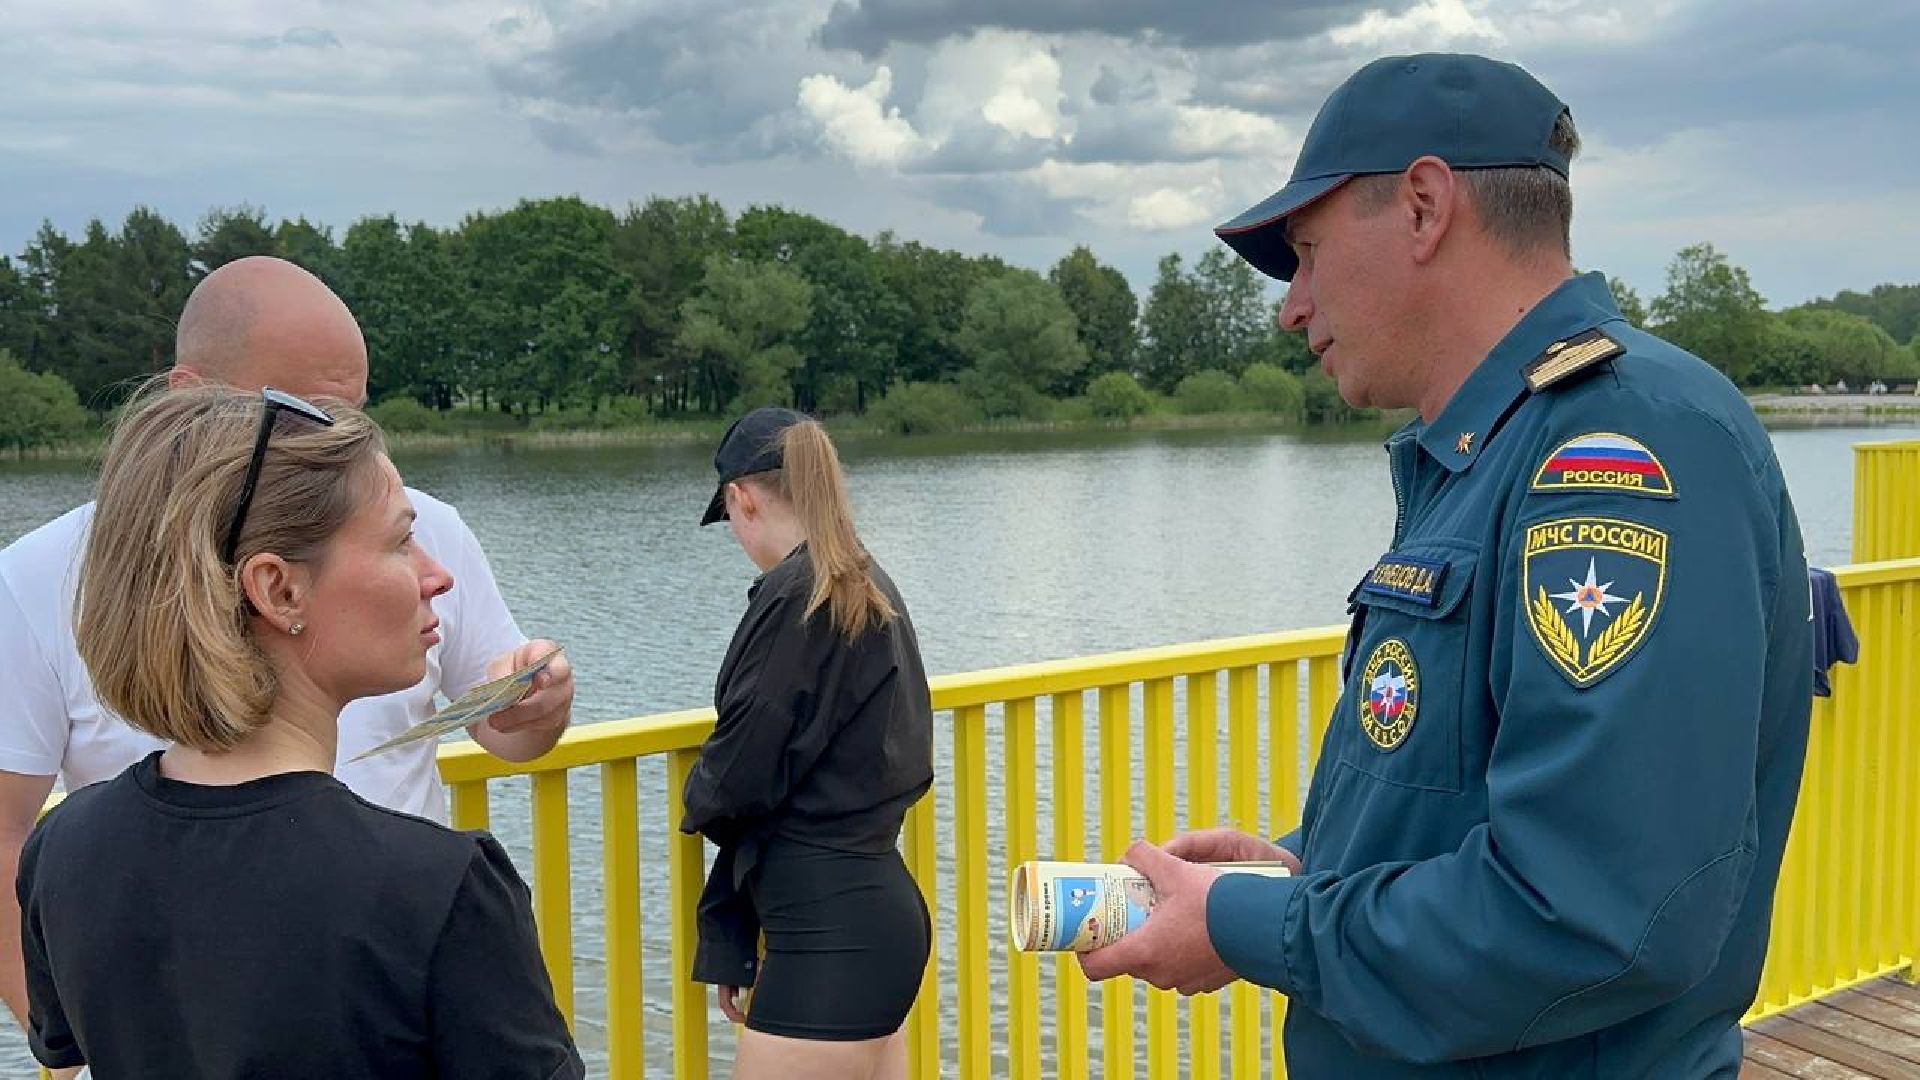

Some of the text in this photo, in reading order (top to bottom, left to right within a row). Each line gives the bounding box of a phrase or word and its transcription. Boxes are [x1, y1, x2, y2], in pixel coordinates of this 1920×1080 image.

[1562, 470, 1643, 486] РОССИЯ
[1530, 524, 1661, 557] МЧС РОССИИ
[1386, 644, 1415, 691] РОССИИ
